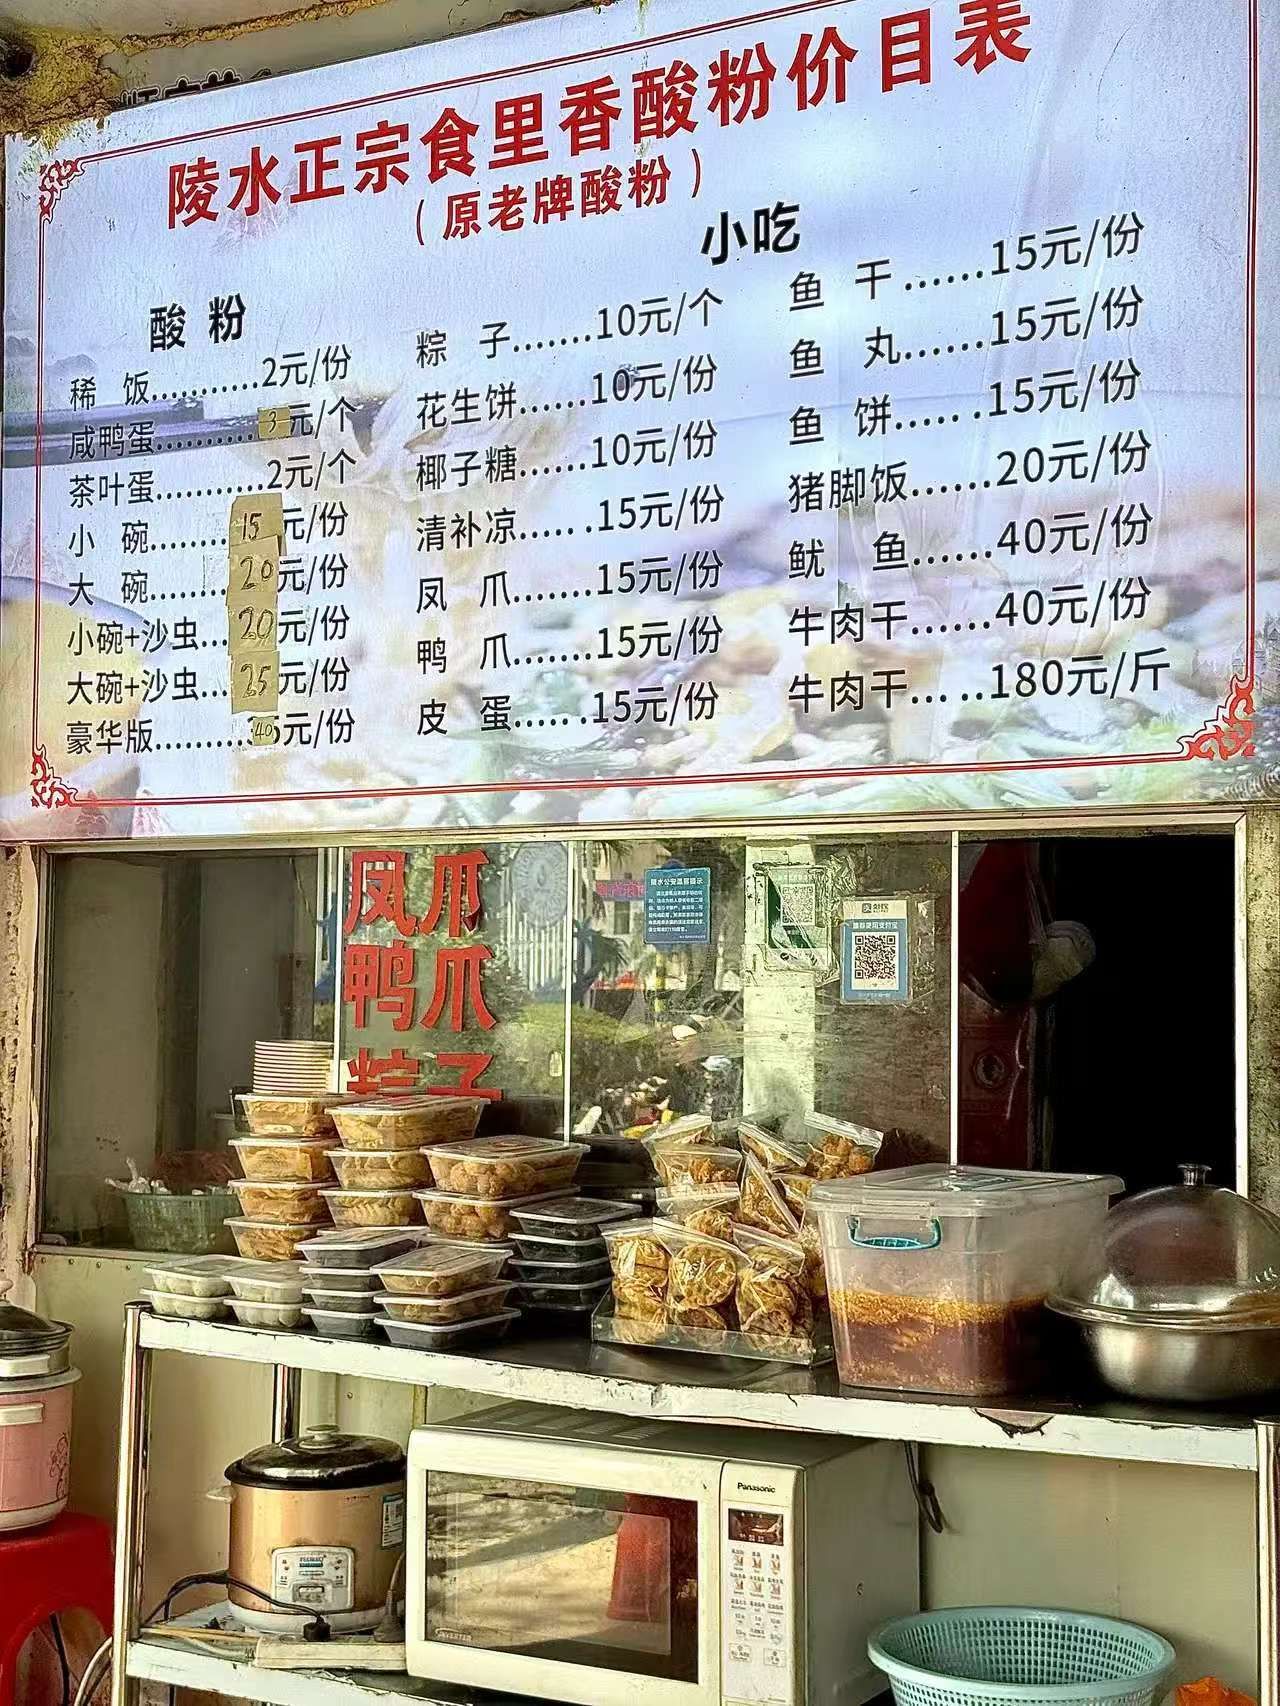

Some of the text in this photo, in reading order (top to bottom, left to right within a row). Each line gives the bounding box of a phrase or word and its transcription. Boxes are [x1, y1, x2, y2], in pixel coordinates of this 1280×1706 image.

[168, 0, 1031, 230] 陵水正宗食里香酸粉价目表
[700, 200, 801, 266] 小吃
[991, 211, 1145, 276] 15元/份
[150, 293, 246, 352] 酸粉
[597, 288, 723, 339] 10元/个
[990, 284, 1144, 347] 15元/份
[262, 344, 351, 388] 2元/份
[416, 353, 718, 430] 花生饼 10元/份
[988, 357, 1142, 413] 15元/份
[69, 421, 155, 460] 咸鸭蛋
[416, 419, 718, 491] 椰子糖 10元/份
[69, 448, 356, 508] 茶叶蛋 2元/个
[788, 429, 1152, 513] 猪脚饭 20元/份
[416, 484, 724, 552] 清补凉 15元/份
[996, 503, 1154, 556] 40元/份
[598, 550, 723, 595] 15元/份
[67, 616, 199, 656] 小碗+沙虫
[598, 615, 723, 660] 15元/份
[788, 576, 1152, 647] 牛肉干 40元/份
[67, 666, 199, 706] 大碗+沙虫
[593, 681, 719, 726] 15元/份
[788, 647, 1171, 714] 牛肉干 180元/斤
[66, 718, 154, 755] 豪华版
[343, 848, 490, 938] 凤爪
[343, 940, 498, 1032] 鸭爪
[737, 1482, 776, 1494] Panasonic
